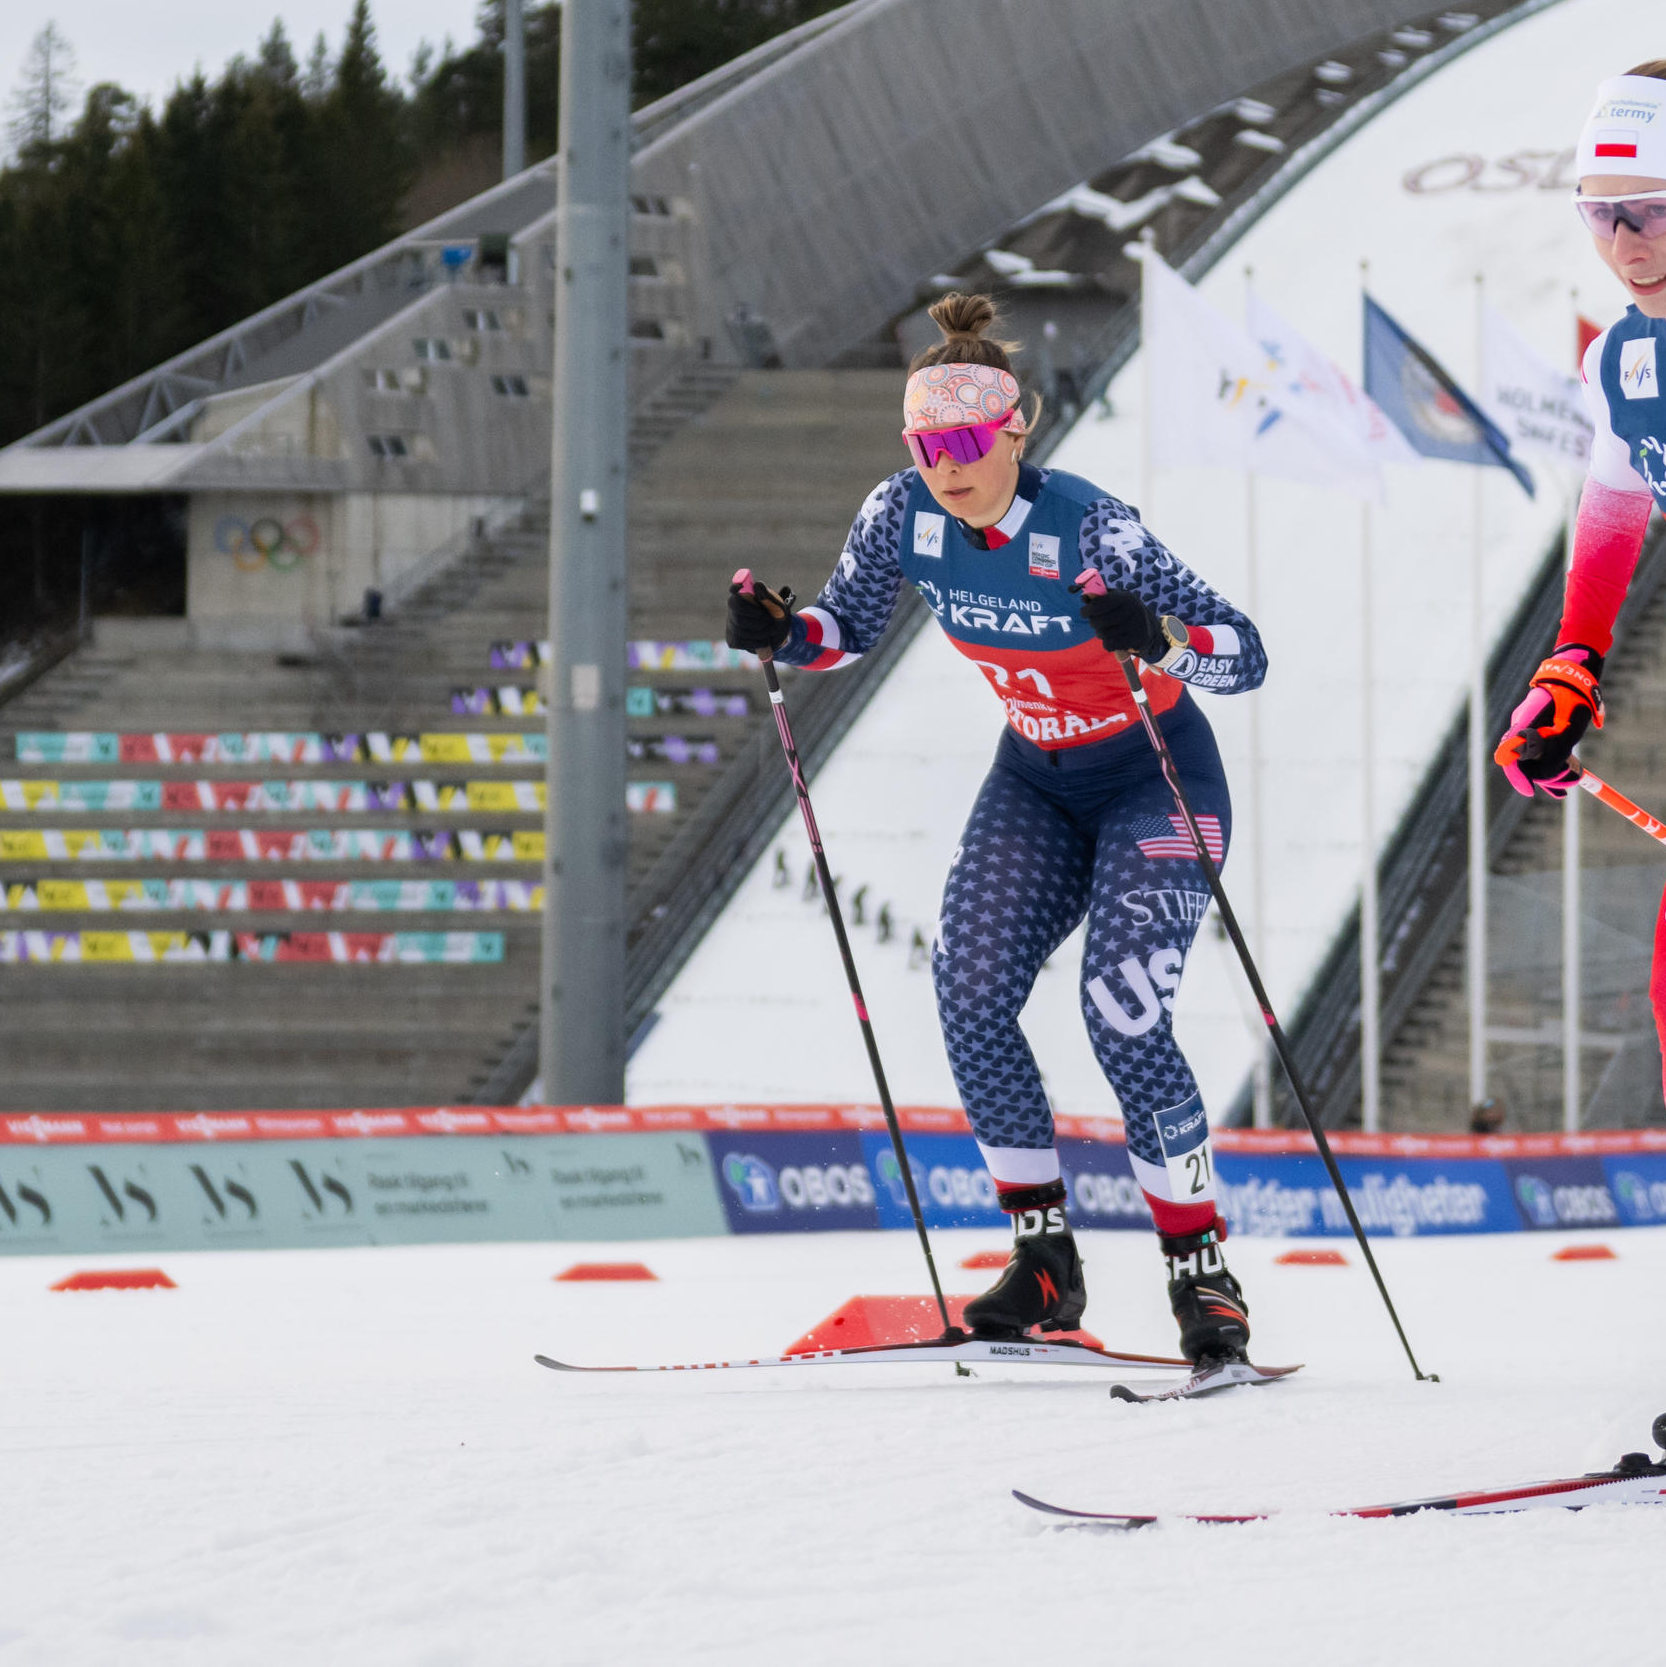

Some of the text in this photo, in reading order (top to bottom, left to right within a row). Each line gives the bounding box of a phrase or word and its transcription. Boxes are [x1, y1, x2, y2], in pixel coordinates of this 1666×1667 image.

[1610, 106, 1656, 123] termy
[949, 589, 1042, 612] HELGELAND
[950, 604, 1073, 635] KRAFT
[1197, 657, 1234, 673] EASY
[1190, 672, 1239, 688] GREEN
[1178, 1110, 1205, 1135] KRAFT
[1186, 1145, 1212, 1195] 21
[779, 1165, 876, 1206] OBOS
[989, 1345, 1031, 1358] MADSHUS
